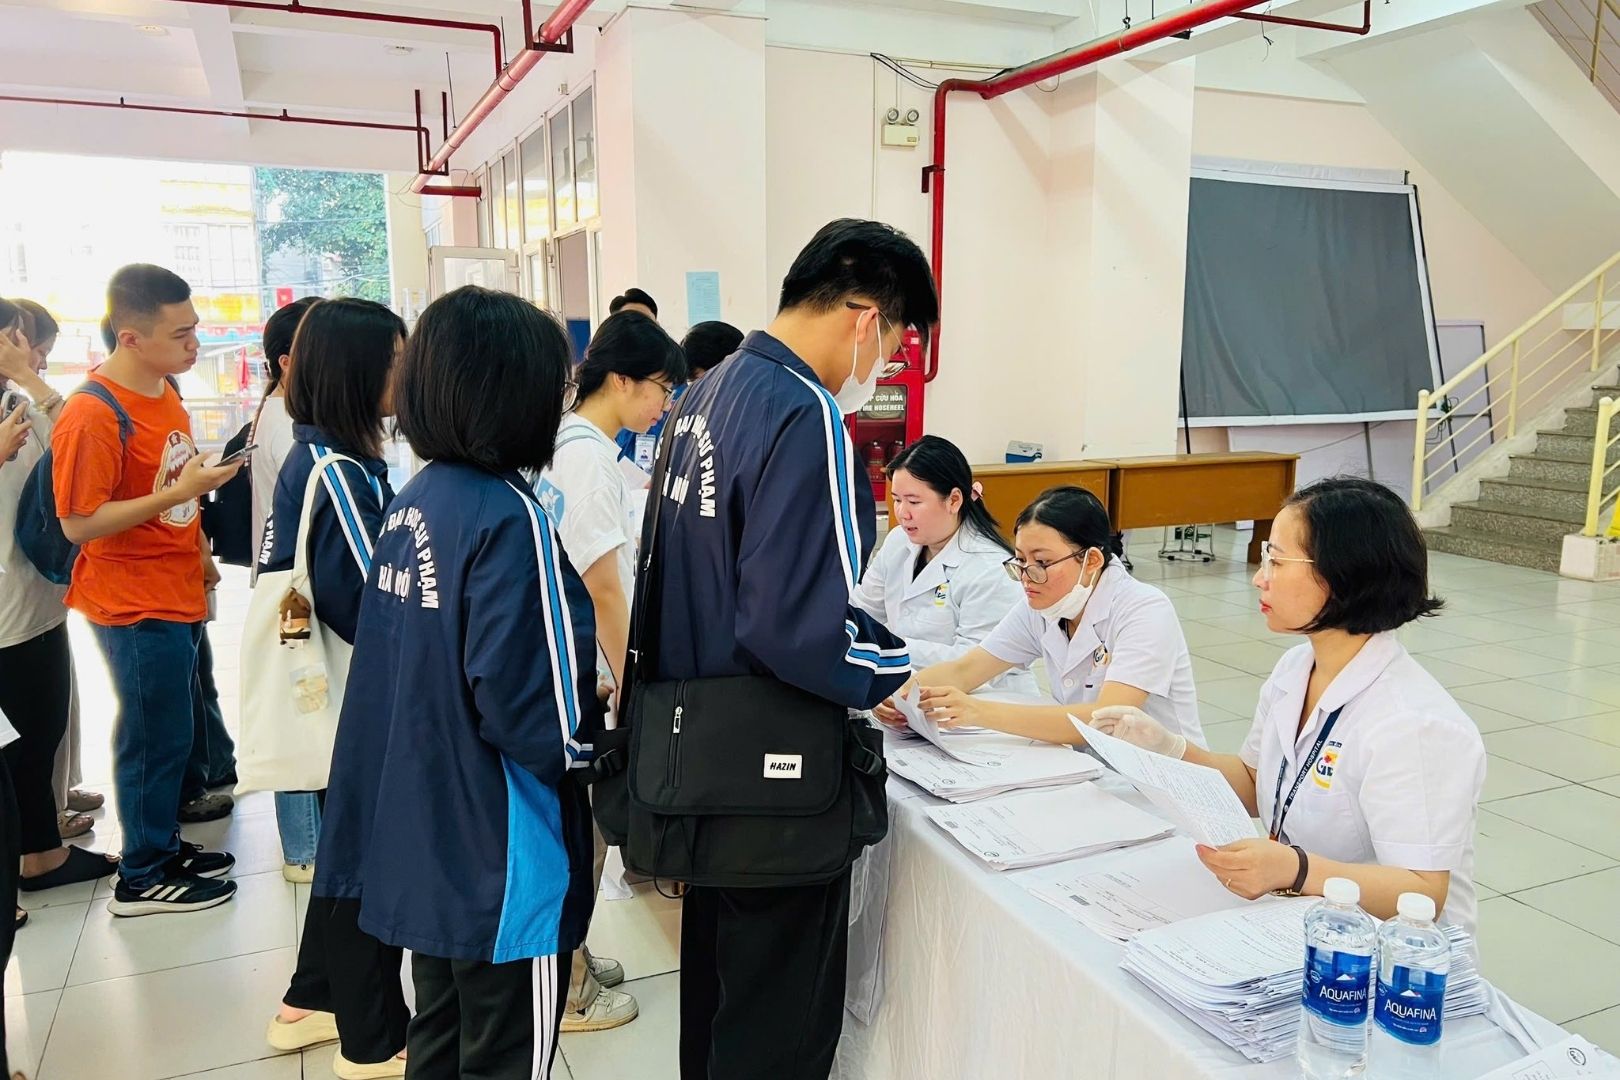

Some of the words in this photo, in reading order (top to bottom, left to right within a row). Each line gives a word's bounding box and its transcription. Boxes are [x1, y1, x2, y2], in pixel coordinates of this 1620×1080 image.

[862, 404, 873, 412] IRE
[698, 455, 716, 518] PHẠM
[377, 562, 393, 593] HÀ
[394, 566, 411, 603] NỘI
[417, 546, 439, 609] PHẠM
[769, 761, 797, 771] HAZIN
[1289, 766, 1309, 800] TRANSPORT
[1306, 739, 1323, 768] HOSPITAL
[1319, 985, 1367, 1003] AQUAFINA
[1384, 999, 1437, 1020] AQUAFINA
